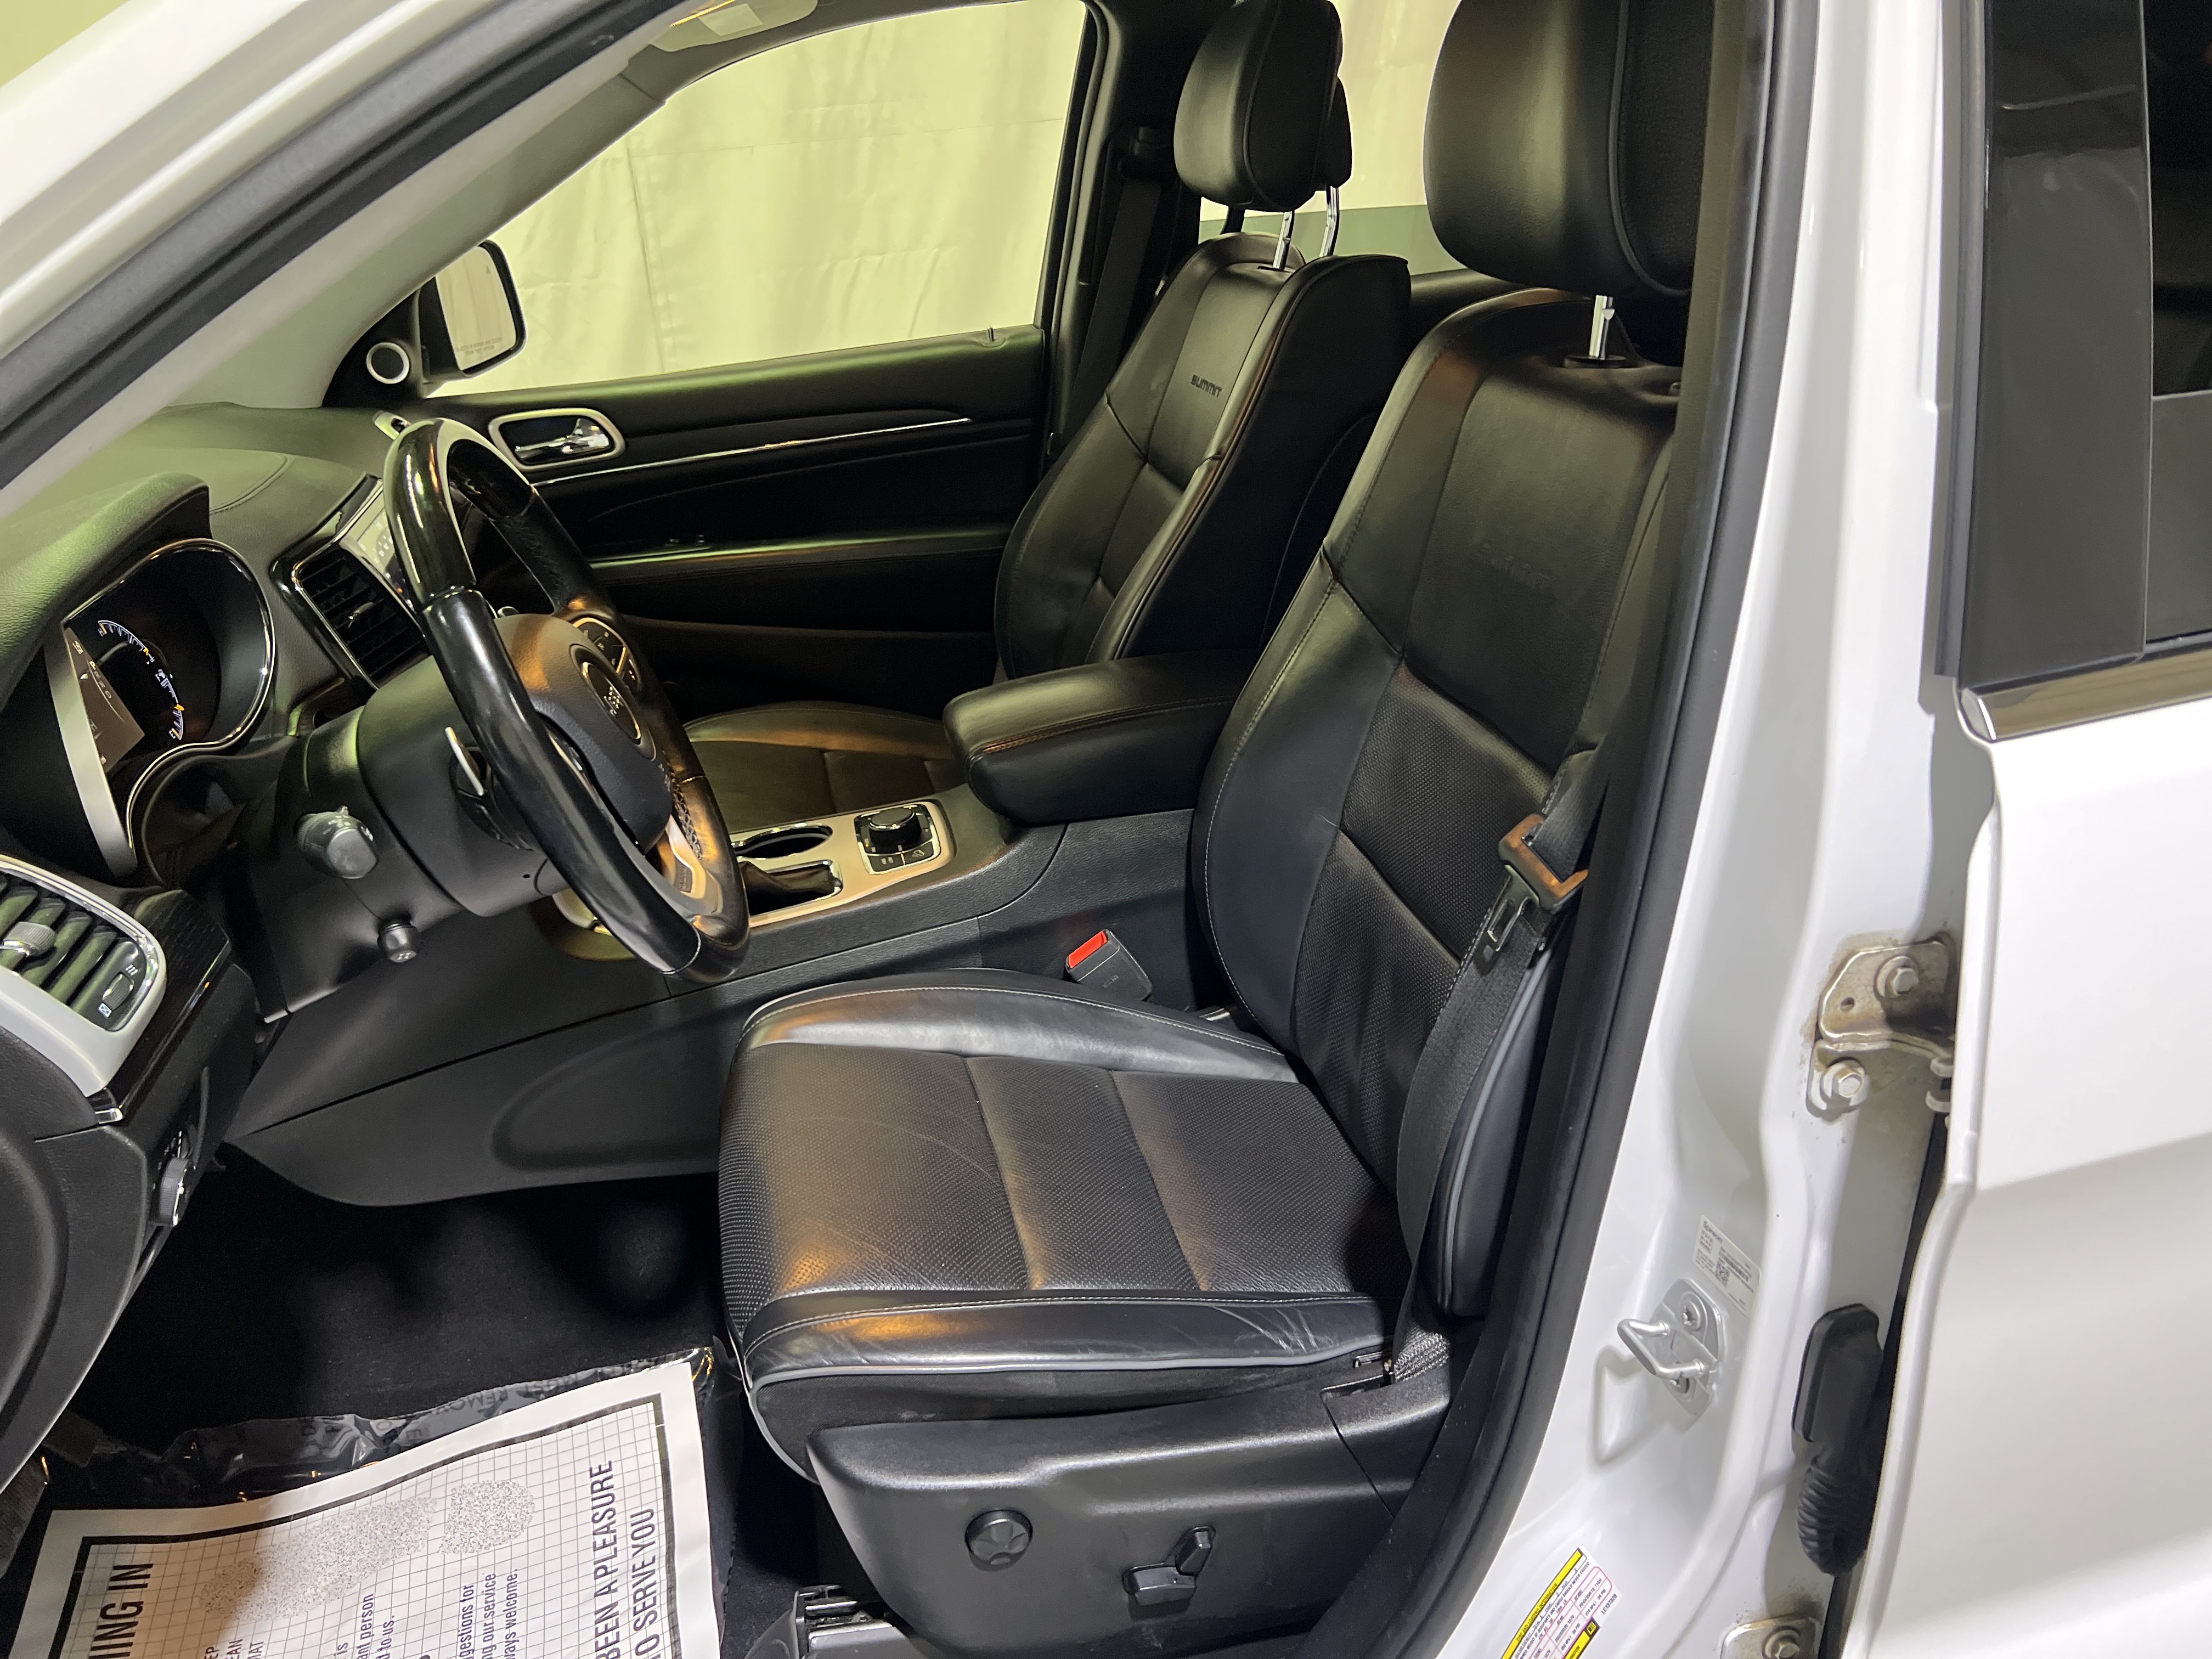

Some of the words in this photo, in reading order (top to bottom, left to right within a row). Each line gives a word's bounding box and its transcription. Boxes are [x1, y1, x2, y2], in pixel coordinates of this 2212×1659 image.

[589, 1460, 618, 1579] PLEASURE
[630, 1509, 656, 1556] YOU
[106, 1564, 153, 1590] IN
[460, 1584, 474, 1601] for
[594, 1579, 617, 1598] A
[633, 1555, 657, 1631] SERVE
[484, 1573, 495, 1618] service
[505, 1568, 517, 1629] welcome.
[360, 1593, 374, 1639] person
[383, 1615, 394, 1634] us.
[482, 1621, 493, 1641] our
[377, 1638, 391, 1650] to
